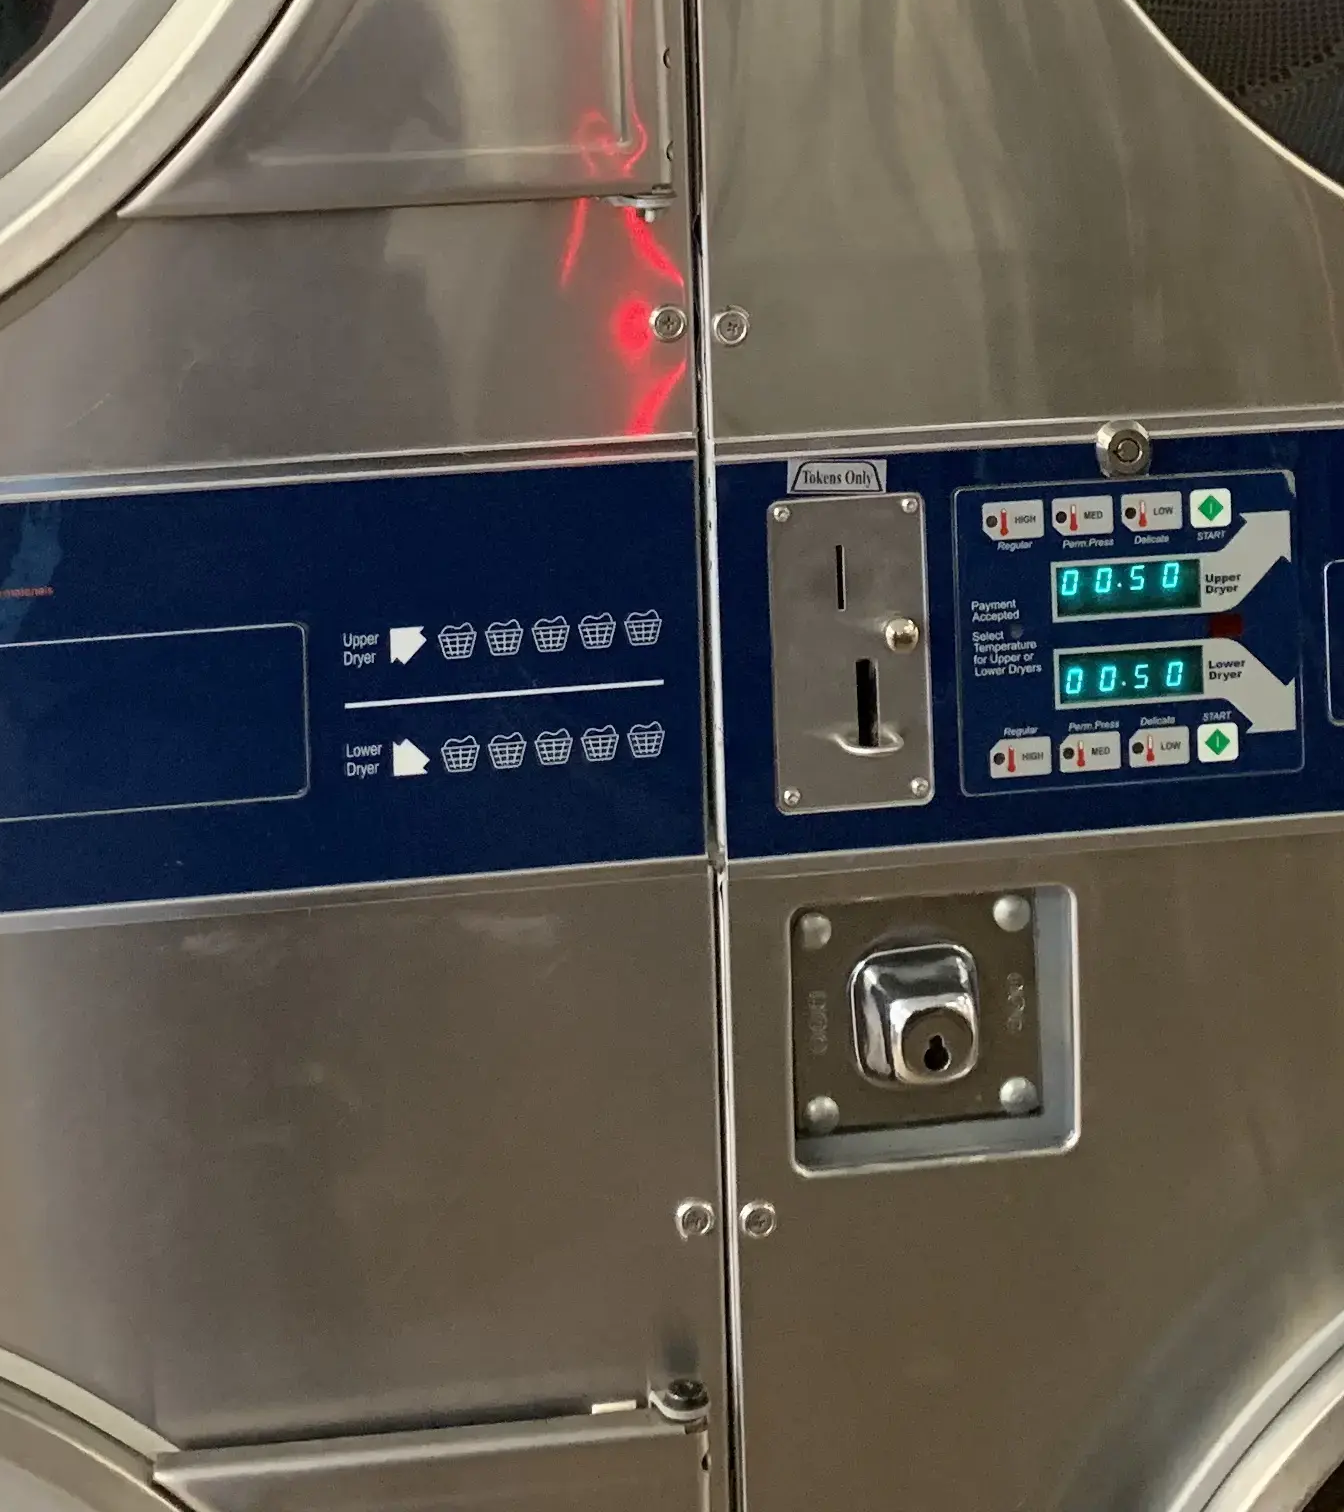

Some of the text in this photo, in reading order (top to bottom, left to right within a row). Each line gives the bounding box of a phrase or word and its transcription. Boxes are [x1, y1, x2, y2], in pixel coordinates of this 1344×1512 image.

[802, 470, 872, 488] Tokens Only
[1084, 511, 1103, 519] MED
[1153, 507, 1173, 516] LOW
[1015, 515, 1036, 524] HIGH
[1134, 535, 1170, 545] Delicate
[1197, 531, 1226, 541] START
[997, 541, 1033, 552] Regular
[1205, 573, 1241, 584] Upper
[1205, 584, 1239, 595] Dryer
[971, 599, 1016, 612] Payment
[972, 609, 1020, 622] Accepted
[343, 632, 379, 649] Upper
[972, 631, 1004, 641] Select
[974, 640, 1037, 653] Temperature
[343, 651, 376, 668] Dryer
[974, 653, 1034, 665] for Upper or
[1208, 660, 1245, 669] Lower
[975, 664, 1042, 677] Lower Dryers
[1209, 670, 1242, 681] Dryer
[1140, 716, 1175, 726] Delicate
[1202, 711, 1233, 722] START
[1003, 726, 1038, 737] Regular
[346, 742, 382, 758] Lower
[1091, 747, 1110, 755] MED
[1160, 742, 1181, 750] LOW
[1022, 752, 1044, 761] HIGH
[346, 762, 380, 778] Dryer
